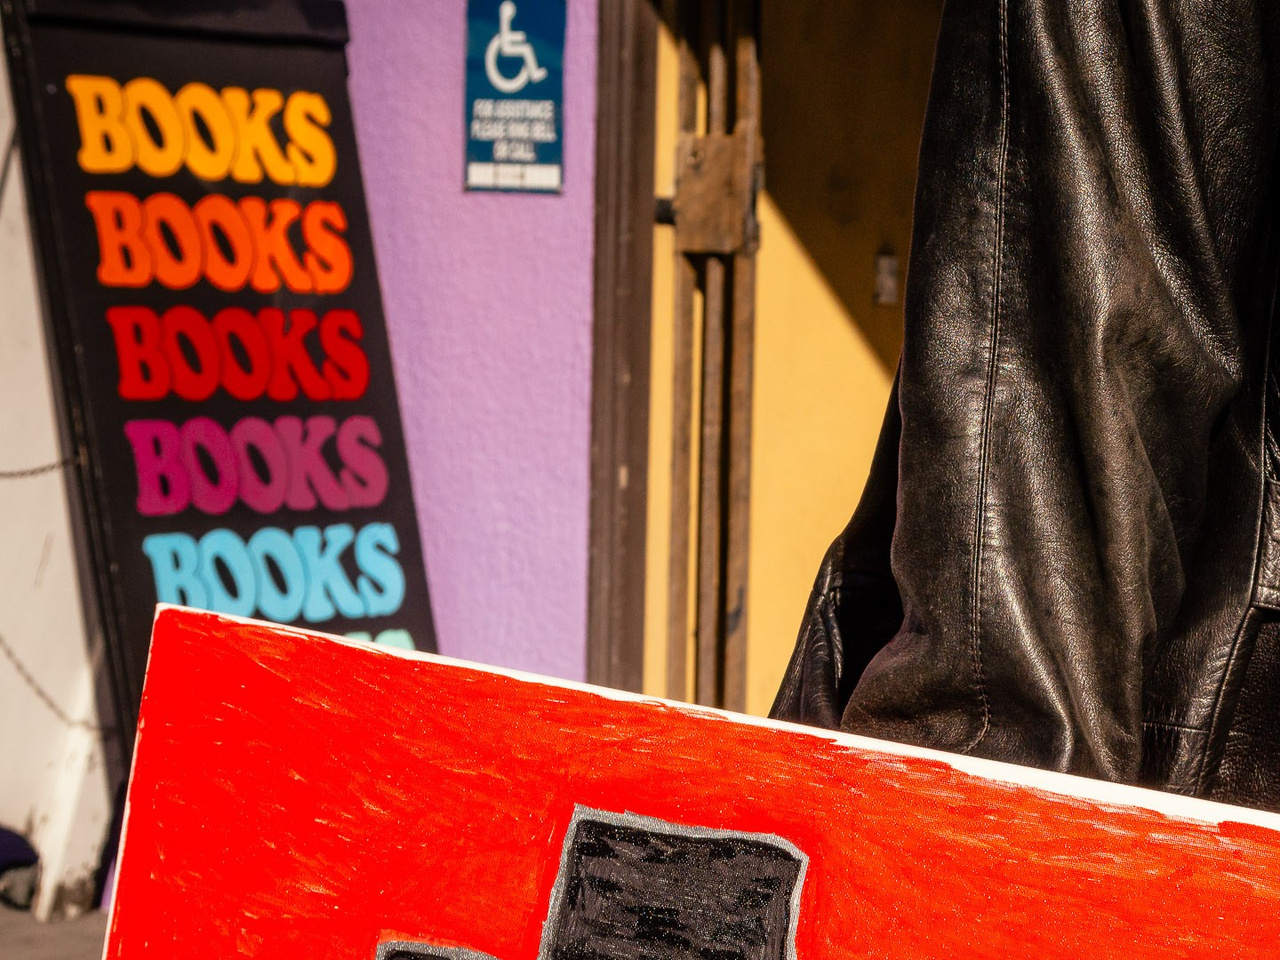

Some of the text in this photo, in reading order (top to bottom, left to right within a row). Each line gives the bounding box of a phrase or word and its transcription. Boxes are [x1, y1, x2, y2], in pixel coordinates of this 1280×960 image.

[66, 74, 336, 188] BOOKS
[85, 191, 354, 294] BOOKS
[105, 305, 370, 401] BOOKS
[125, 414, 389, 516] BOOKS
[142, 522, 406, 622] BOOKS
